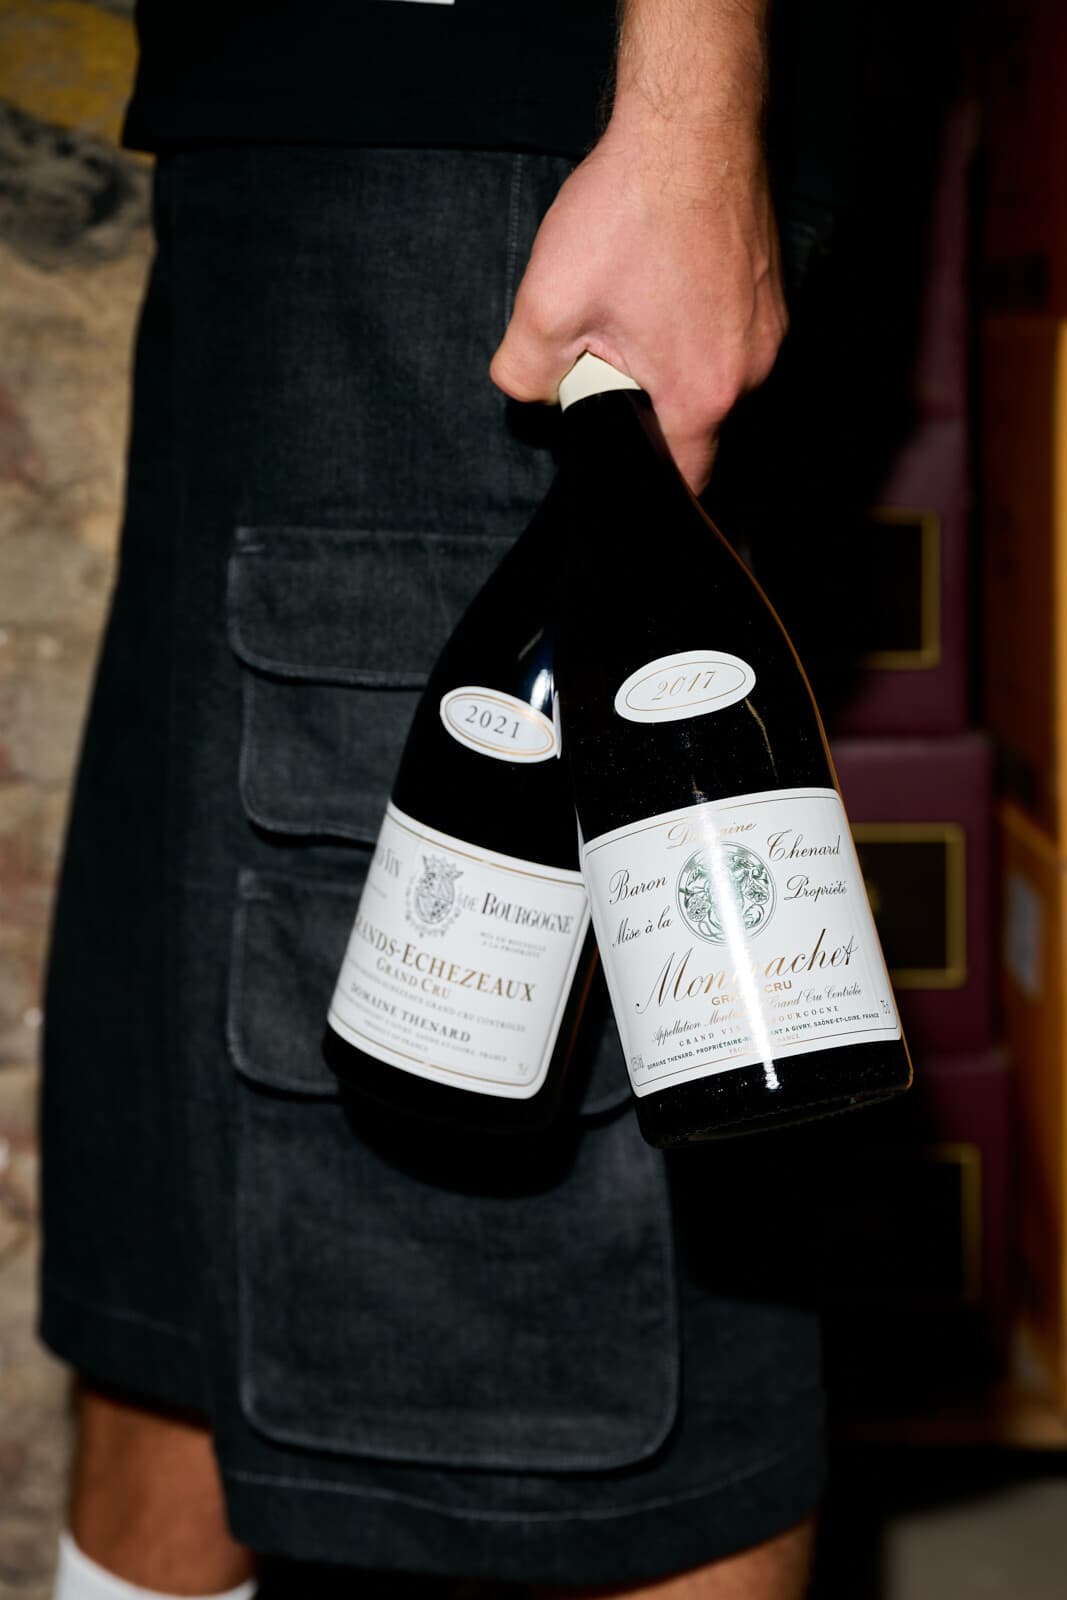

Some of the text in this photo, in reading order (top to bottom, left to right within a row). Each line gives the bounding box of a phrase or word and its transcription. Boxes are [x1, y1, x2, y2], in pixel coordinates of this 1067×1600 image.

[651, 671, 718, 702] 2017
[465, 705, 521, 739] 2021
[766, 829, 841, 862] Thenard
[608, 869, 666, 904] Baron
[784, 874, 848, 902] Propriété
[481, 892, 574, 935] BOURGOGNE
[612, 905, 672, 948] Mise à la
[376, 957, 419, 988] GRAND
[421, 977, 452, 1000] CRU
[764, 980, 793, 993] CRU
[402, 1010, 472, 1043] THENARD
[771, 1004, 839, 1023] OURGOGNE
[652, 1018, 702, 1048] Appellation
